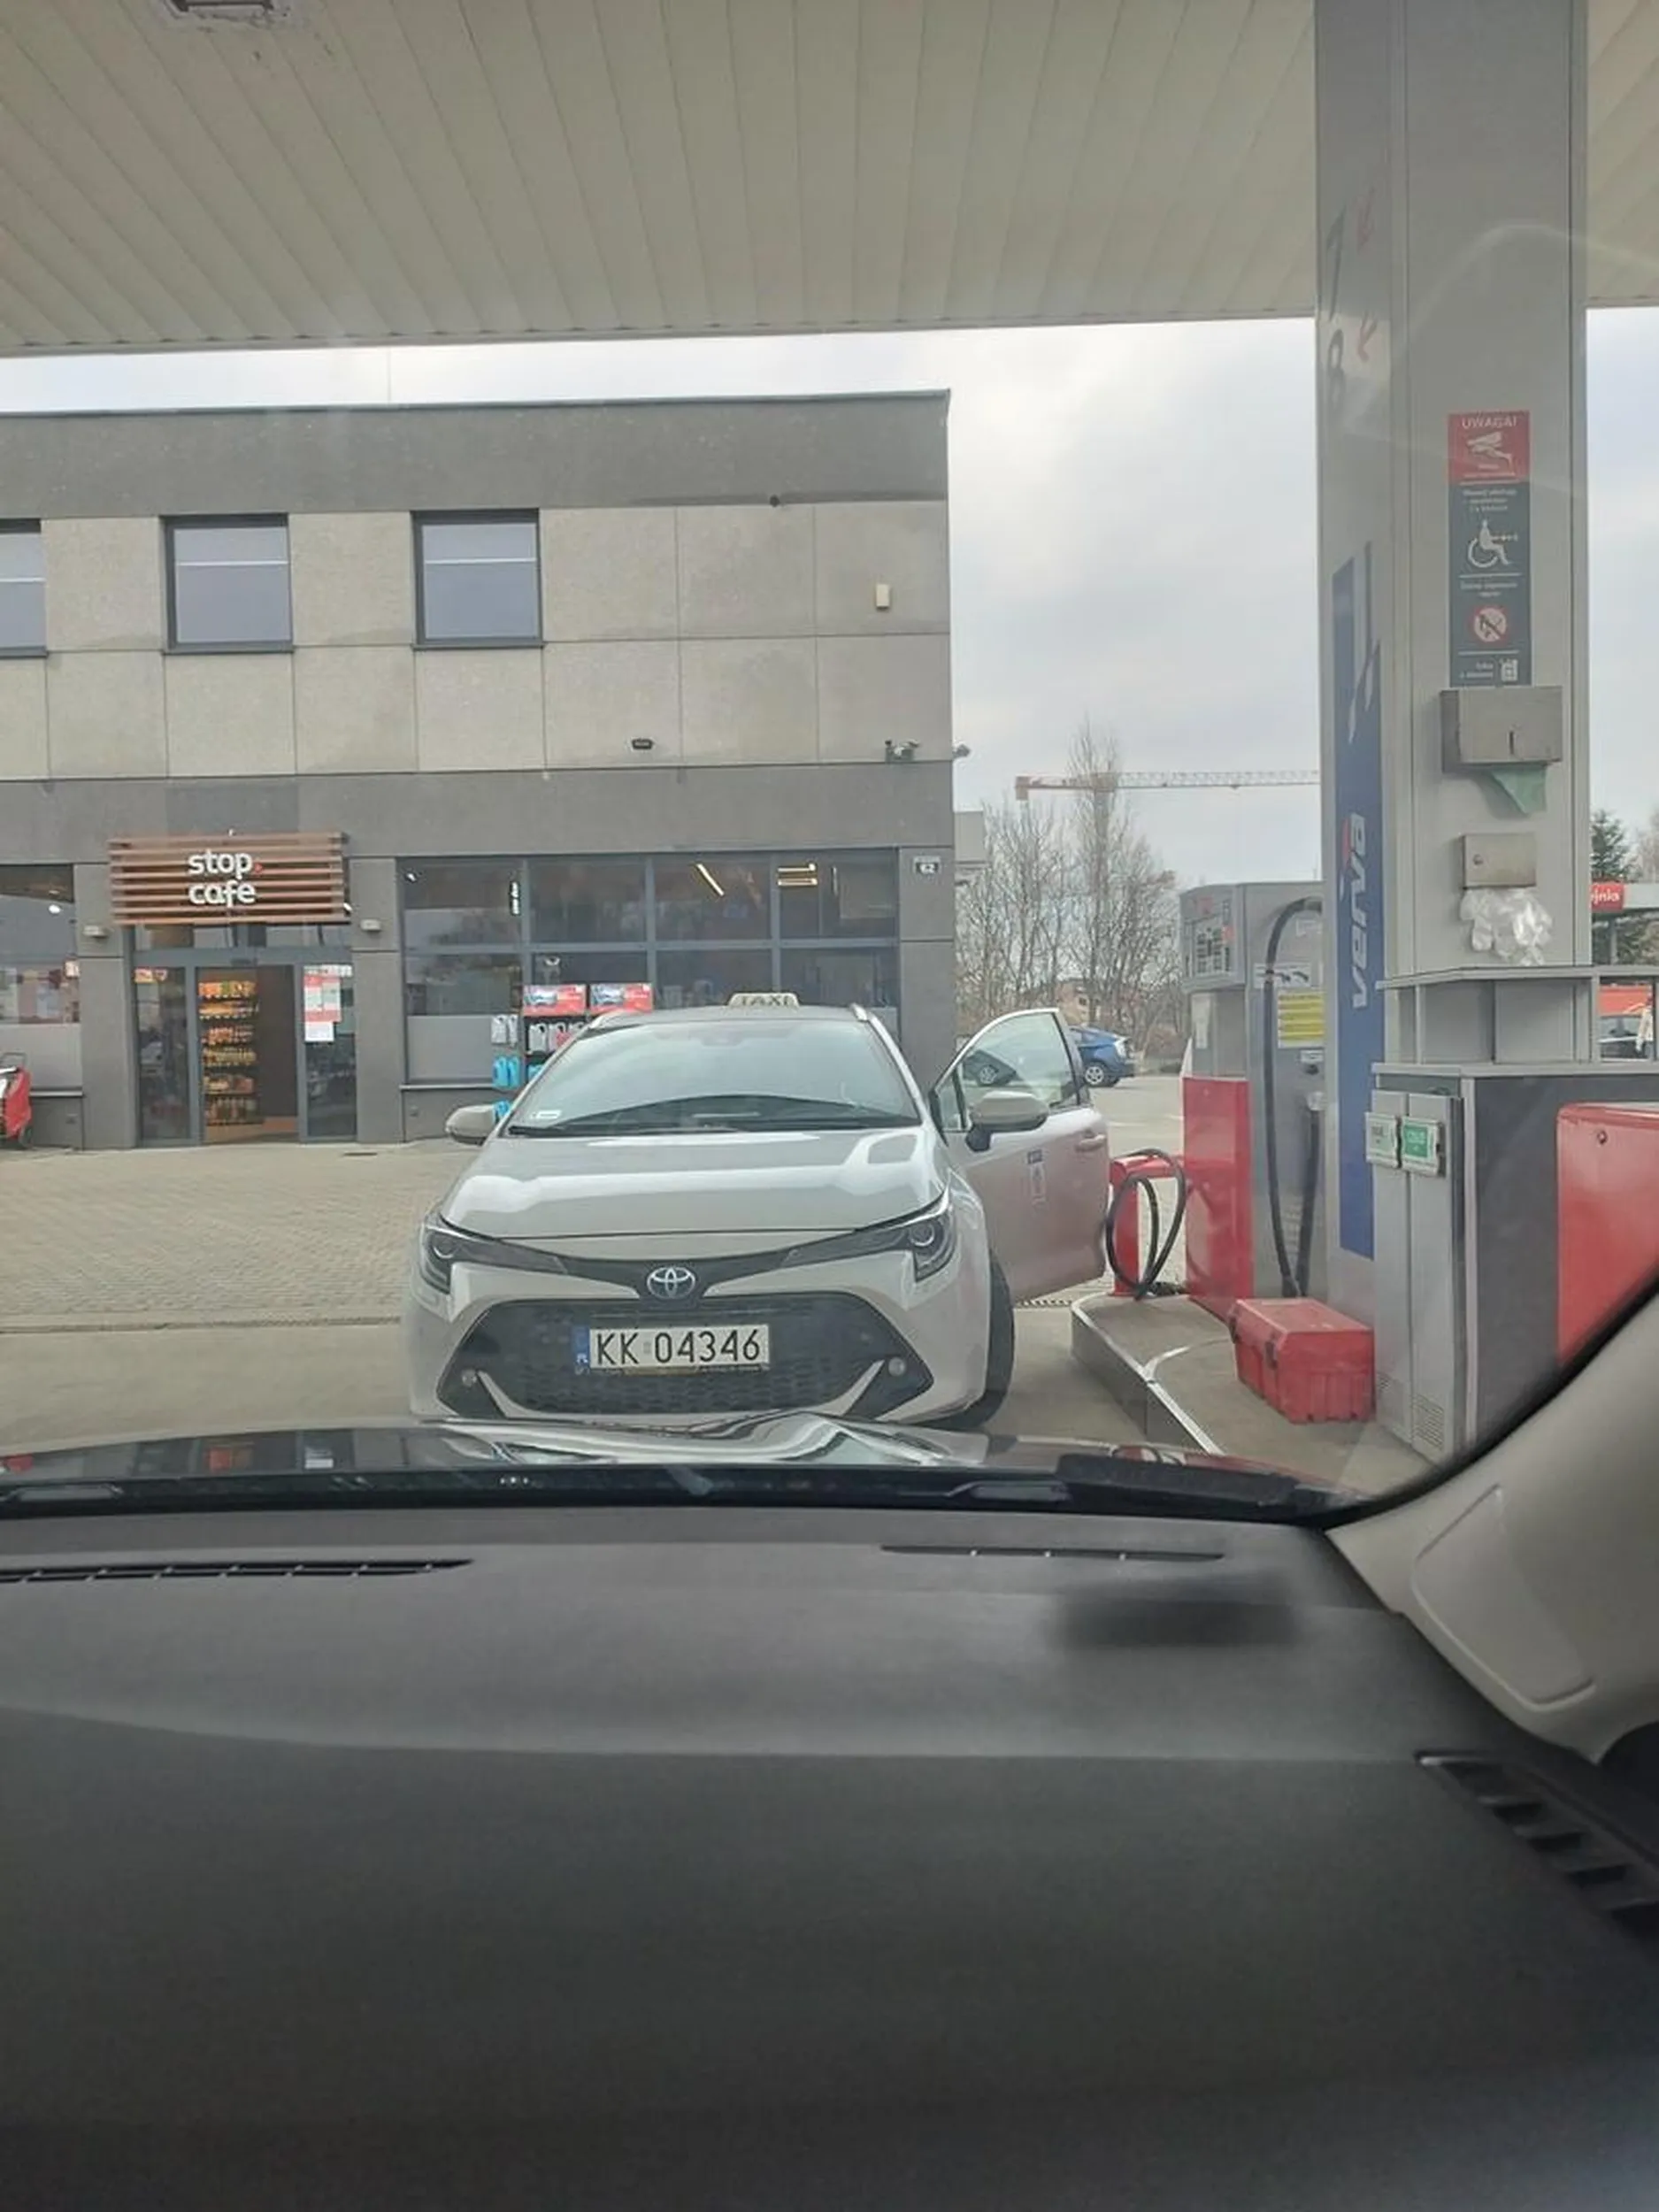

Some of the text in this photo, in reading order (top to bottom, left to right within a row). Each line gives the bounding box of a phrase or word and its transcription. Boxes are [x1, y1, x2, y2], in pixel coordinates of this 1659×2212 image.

[1462, 416, 1517, 429] UWAGA!
[188, 879, 256, 909] cafe
[1350, 812, 1367, 1009] verva
[741, 995, 789, 1006] TAXI
[596, 1329, 760, 1364] KK 04346
